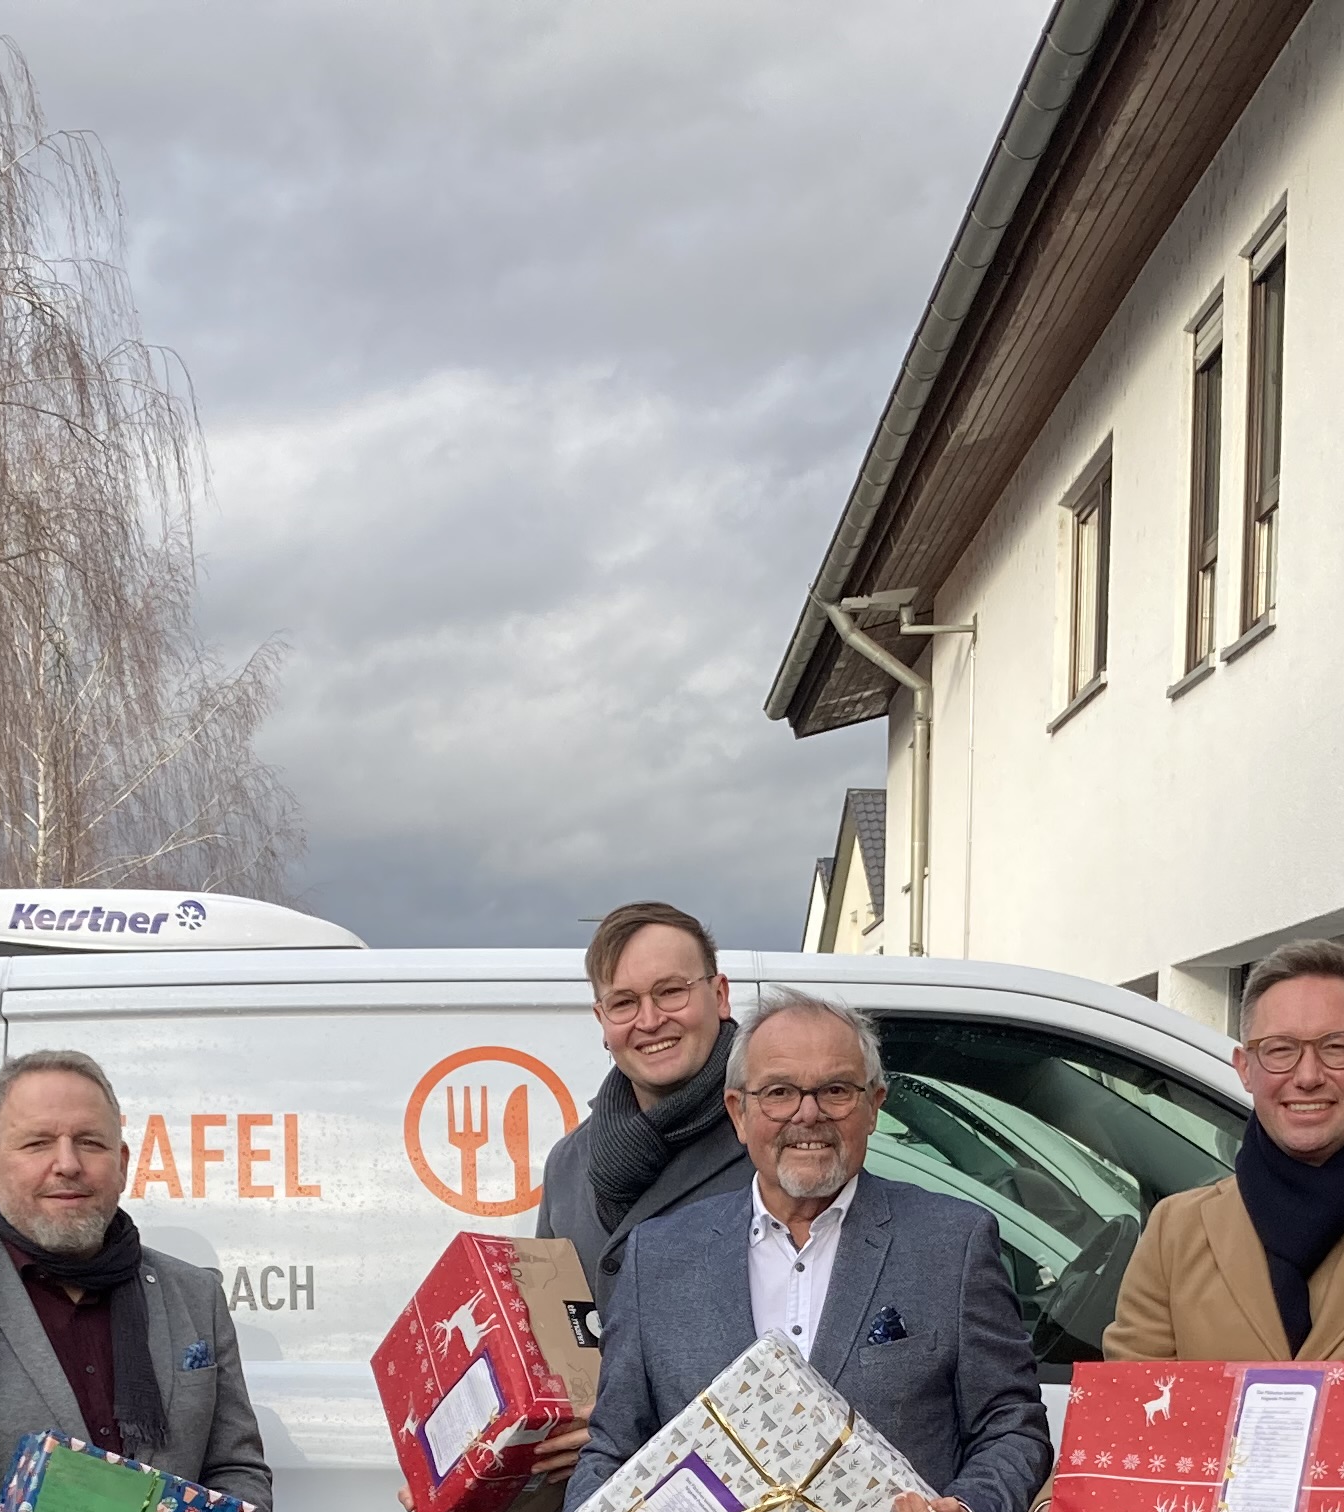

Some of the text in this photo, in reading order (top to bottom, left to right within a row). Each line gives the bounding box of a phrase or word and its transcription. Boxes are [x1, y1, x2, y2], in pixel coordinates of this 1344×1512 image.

[8, 903, 169, 935] Kerstner
[121, 1114, 322, 1199] AFEL
[201, 1265, 315, 1311] ACH
